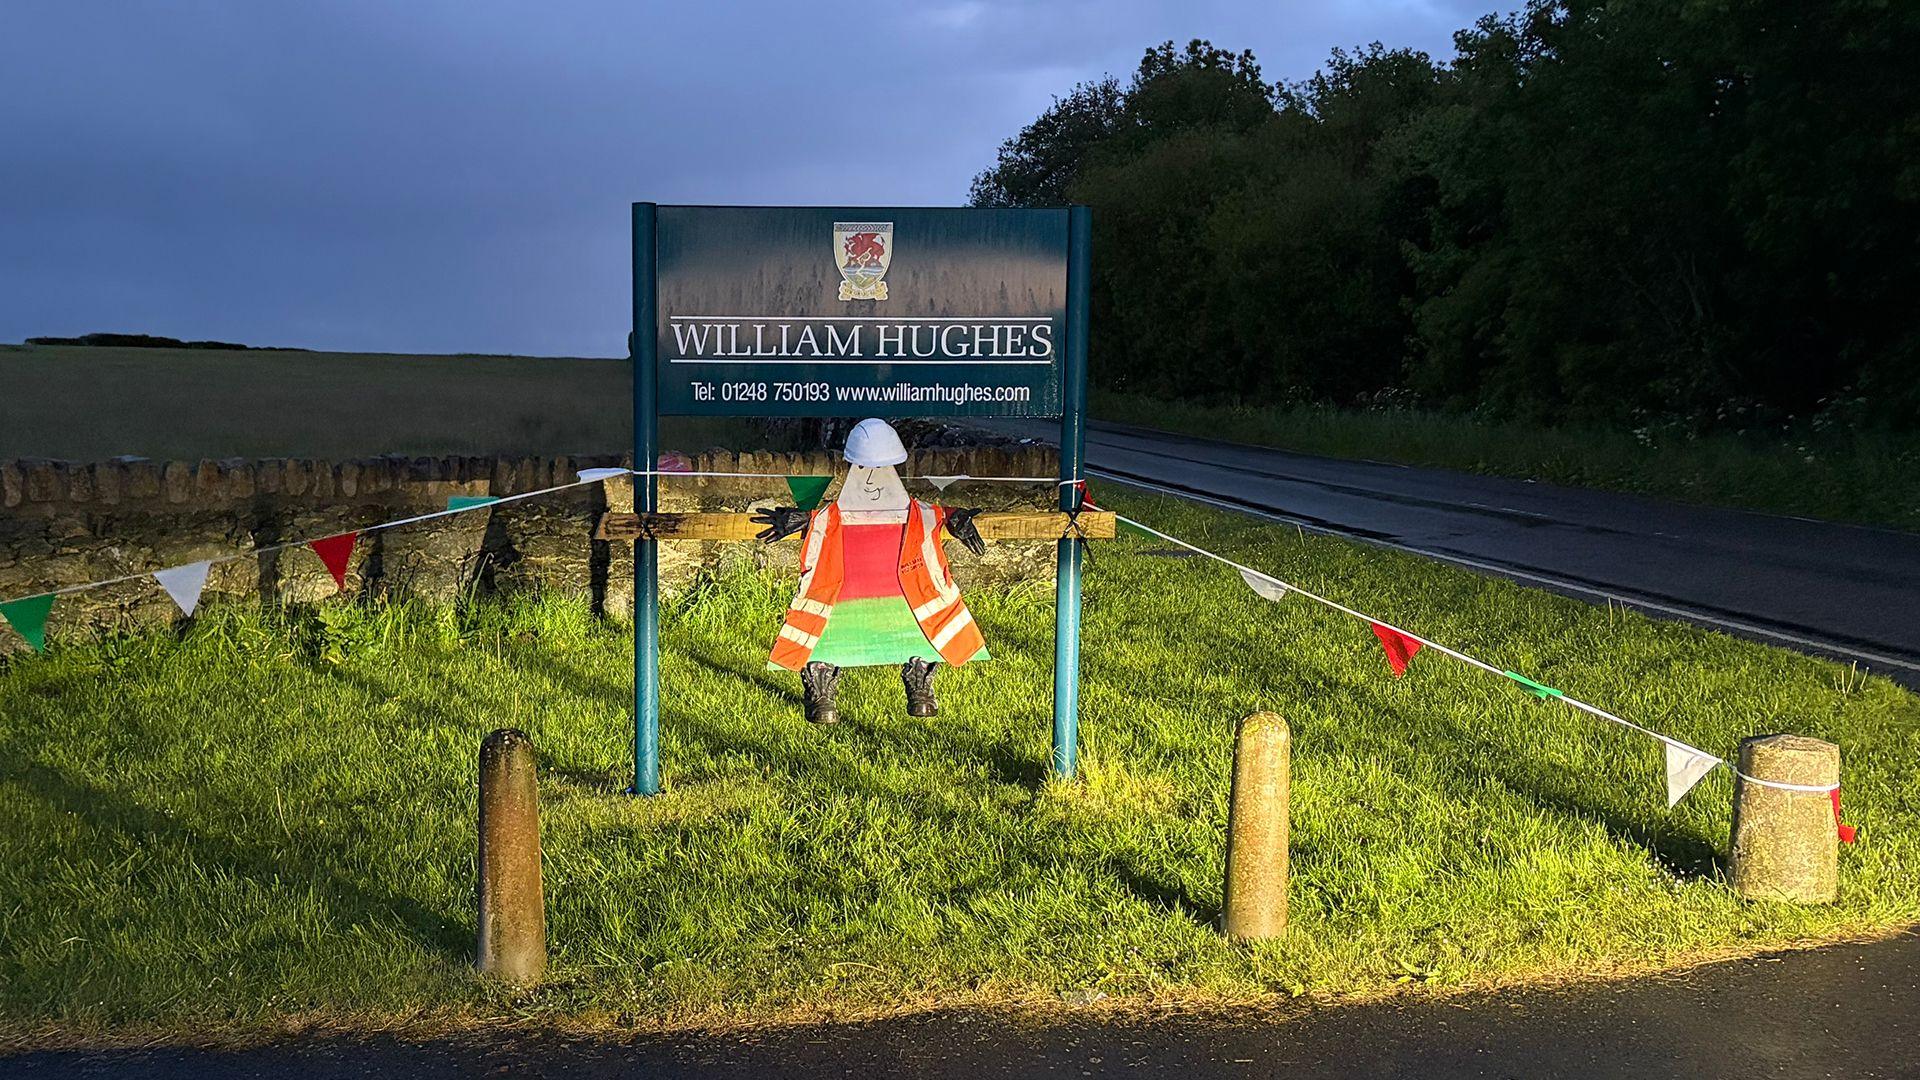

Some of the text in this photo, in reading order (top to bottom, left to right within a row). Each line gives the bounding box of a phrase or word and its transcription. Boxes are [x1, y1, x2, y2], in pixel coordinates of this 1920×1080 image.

[670, 323, 1053, 358] WILLIAM HUGHES
[691, 382, 1030, 406] Tel: 01248 750193 www.williamhughes.com
